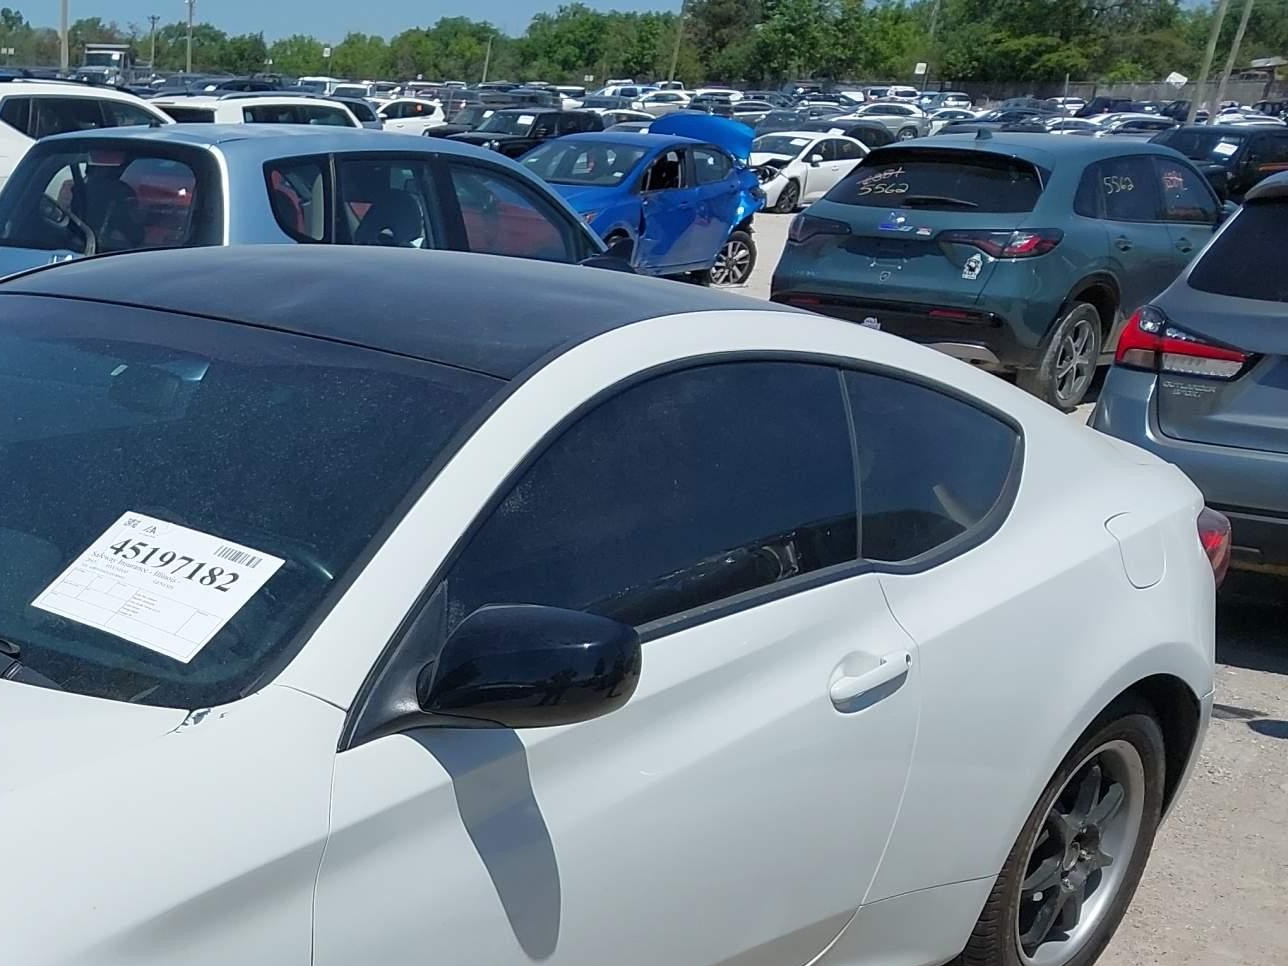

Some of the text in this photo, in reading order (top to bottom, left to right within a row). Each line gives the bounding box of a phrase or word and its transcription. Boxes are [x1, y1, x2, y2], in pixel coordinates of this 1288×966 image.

[857, 183, 909, 196] 5562
[1103, 175, 1134, 194] 5562
[109, 537, 241, 593] 45197182
